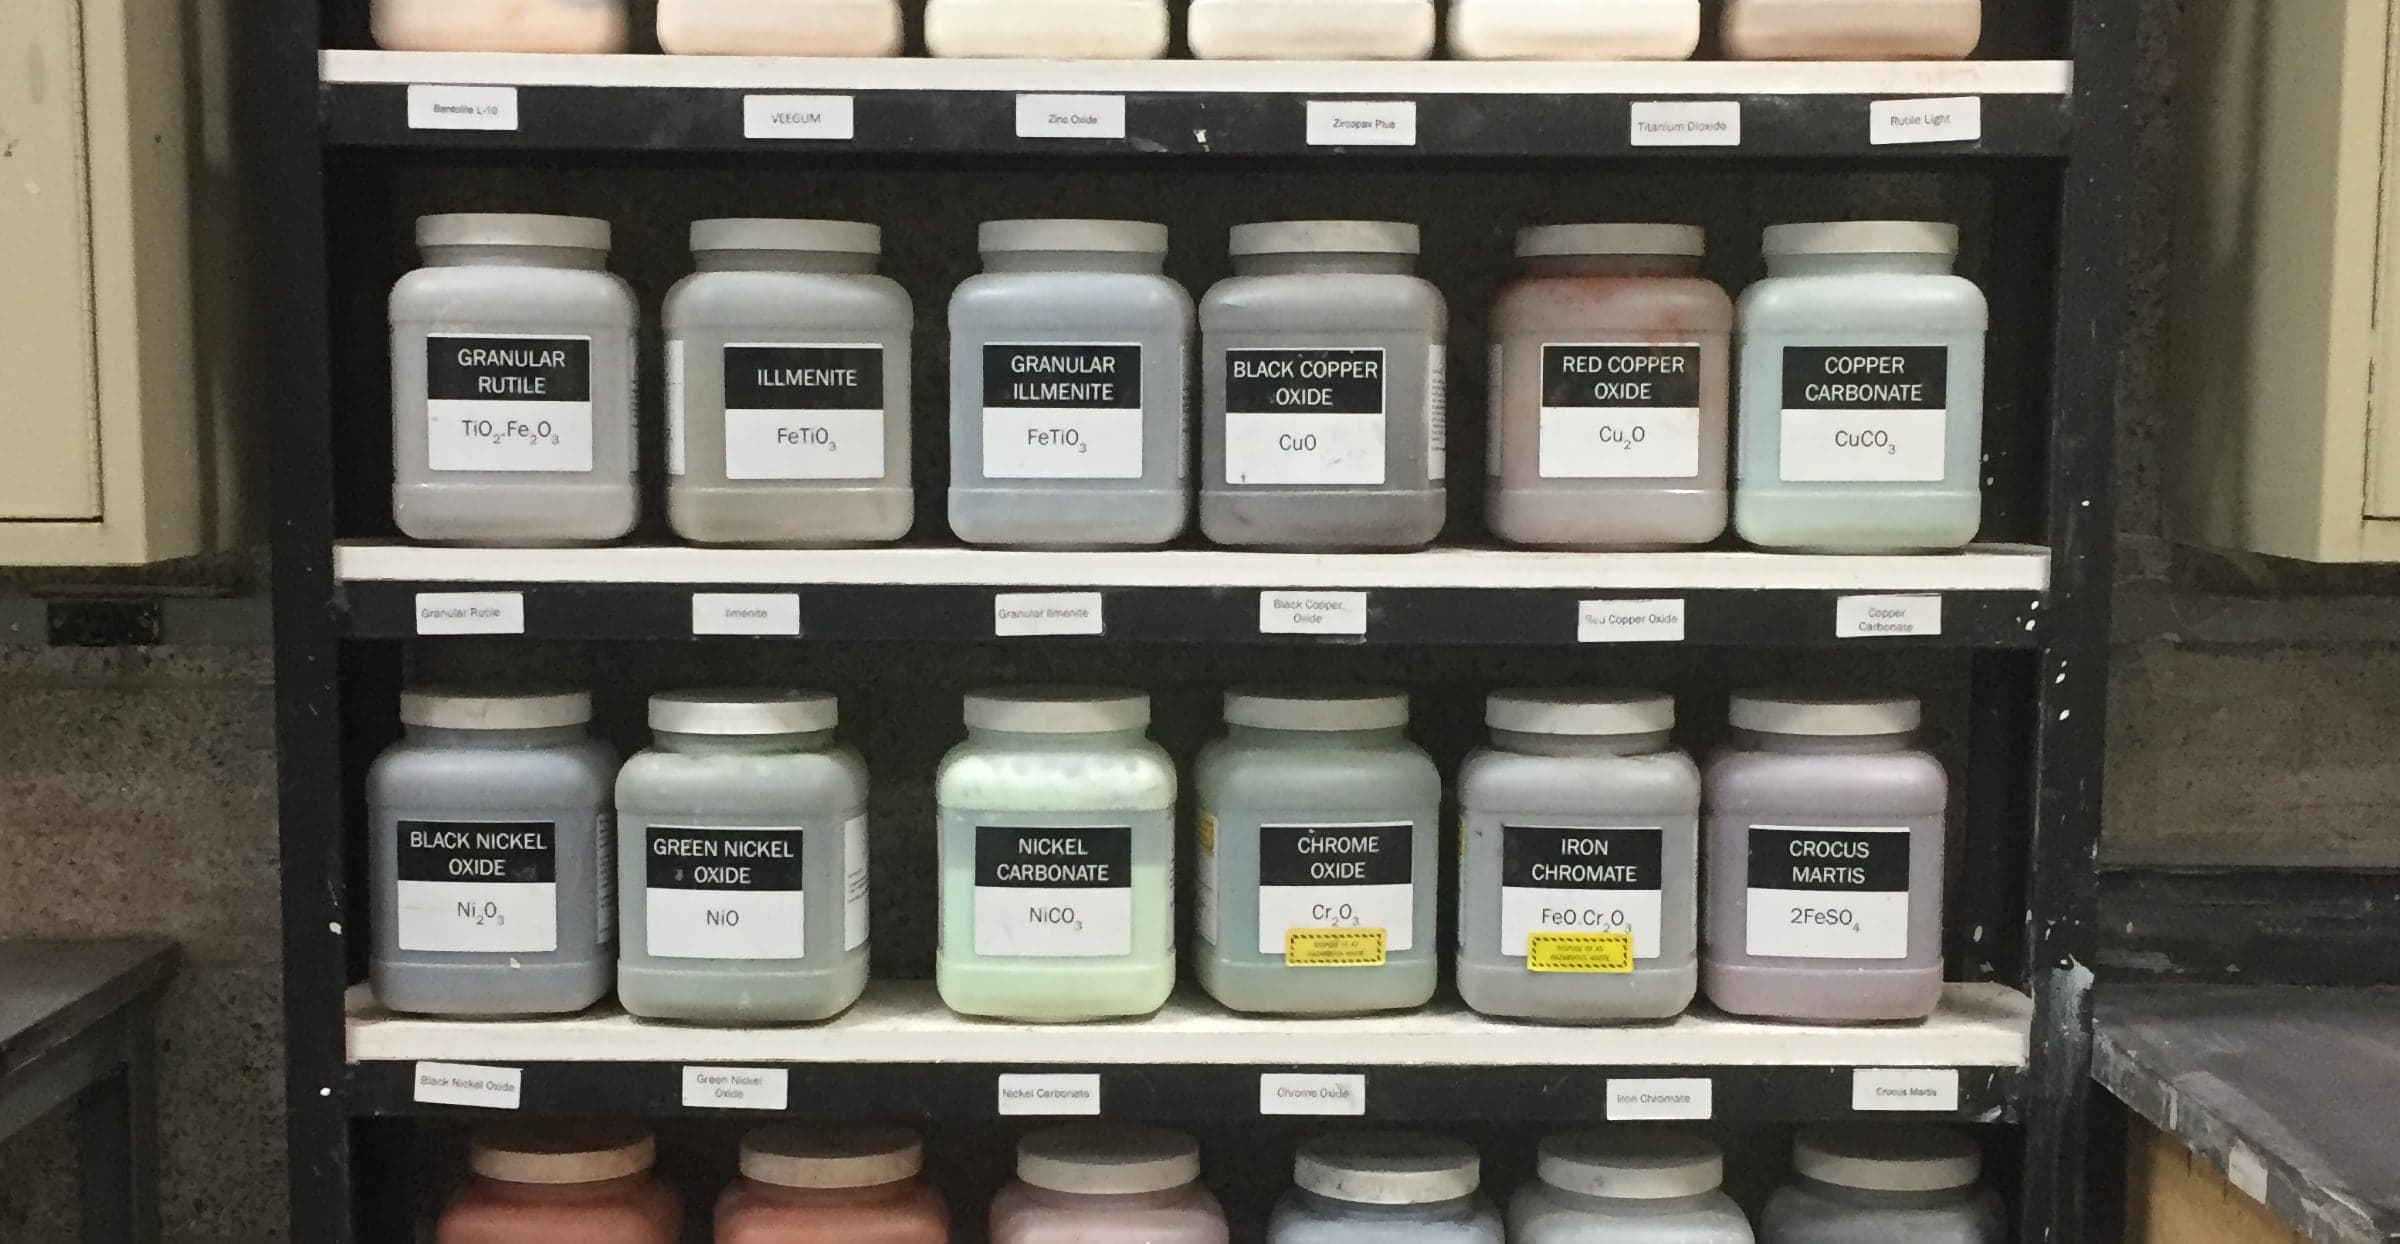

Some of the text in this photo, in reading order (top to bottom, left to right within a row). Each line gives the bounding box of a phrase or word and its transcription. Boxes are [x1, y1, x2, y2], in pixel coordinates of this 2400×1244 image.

[771, 112, 822, 125] VEEGUM
[1048, 114, 1098, 126] Zinc Oxide
[1374, 119, 1395, 130] Plus
[1638, 120, 1727, 132] Titanium Dioxide
[1890, 112, 1951, 128] Rutile Light
[457, 348, 565, 368] GRANULAR
[1011, 355, 1116, 374] GRANULAR
[1563, 356, 1685, 374] RED COPPER
[1824, 356, 1905, 374] COPPER
[757, 369, 858, 387] ILLMENITE
[1234, 360, 1378, 379] BLACK COPPER
[478, 376, 546, 394] RUTILE
[1013, 382, 1114, 401] ILLMENITE
[1594, 382, 1653, 400] OXIDE
[1805, 383, 1922, 402] CARBONATE
[1276, 387, 1334, 406] OXIDE
[1279, 434, 1317, 451] CuO
[421, 607, 501, 619] Granular Rutile
[999, 608, 1045, 619] Granular
[1273, 599, 1342, 611] Black Copper
[1868, 608, 1906, 619] Copper
[1293, 613, 1322, 624] Oxide
[1608, 614, 1646, 626] Copper
[1649, 614, 1678, 624] Oxide
[1858, 621, 1914, 632] Carbonate
[410, 831, 548, 850] BLACK NICKEL
[653, 839, 794, 858] GREEN NICKEL
[1018, 838, 1088, 856] NICKEL
[1297, 836, 1379, 854] CHROME
[1561, 838, 1608, 856] IRON
[1789, 840, 1869, 859] CROCUS
[449, 858, 506, 876] OXIDE
[694, 866, 751, 884] OXIDE
[996, 863, 1110, 882] CARBONATE
[1310, 862, 1366, 879] OXIDE
[1531, 863, 1637, 882] CHROMATE
[1792, 867, 1866, 884] MARTIS
[706, 910, 739, 926] NiO
[1790, 908, 1860, 933] 2FeSO4
[420, 1075, 515, 1092] Black Nickel Oxide
[696, 1074, 763, 1086] Green Nickel
[714, 1088, 744, 1099] Oxide
[1002, 1088, 1090, 1099] Nickel Carbonate
[1277, 1088, 1349, 1099] Chrome Oxide
[1617, 1093, 1690, 1104] Iron Chromate
[1876, 1086, 1937, 1097] Crocus Martis
